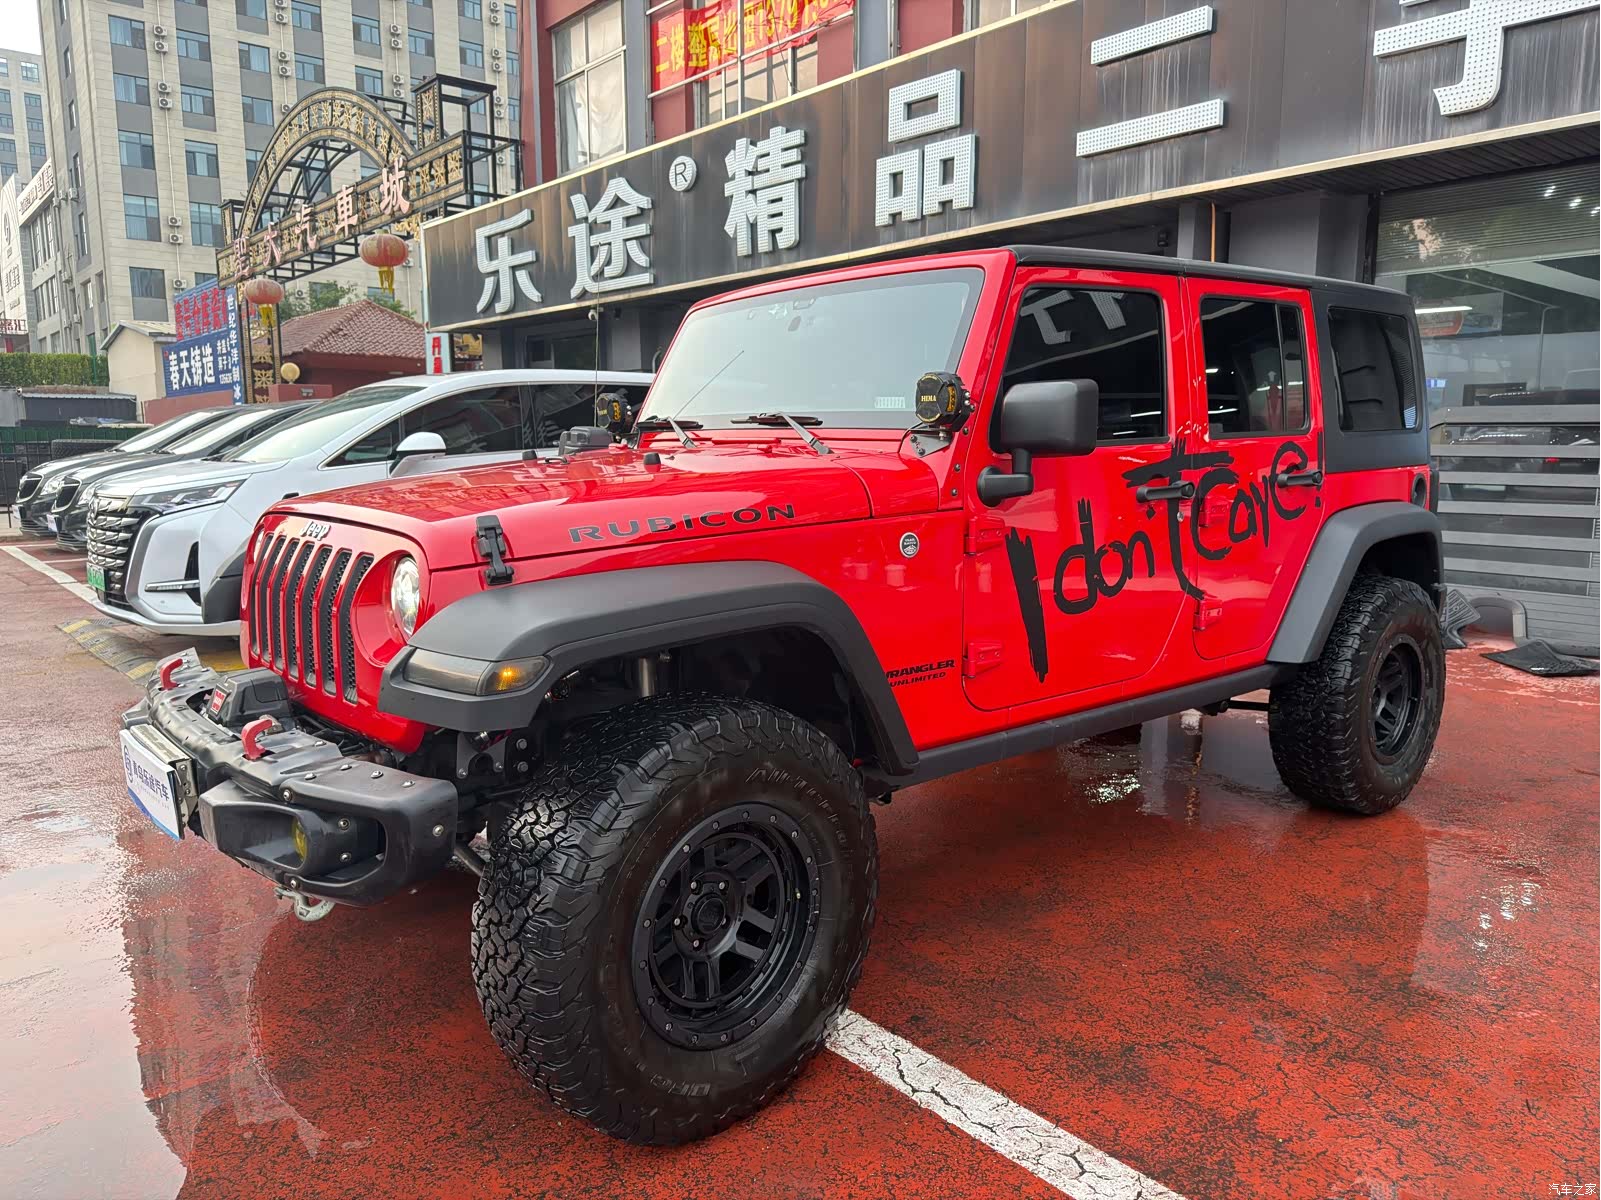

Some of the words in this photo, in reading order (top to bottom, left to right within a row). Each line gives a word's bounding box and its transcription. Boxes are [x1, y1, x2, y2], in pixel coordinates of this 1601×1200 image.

[169, 342, 215, 390] 春天铸造
[227, 294, 242, 405] 世纪华洋制冰
[300, 521, 332, 541] Jeep
[568, 503, 795, 543] RUBICON
[889, 671, 946, 688] UNLIMITED
